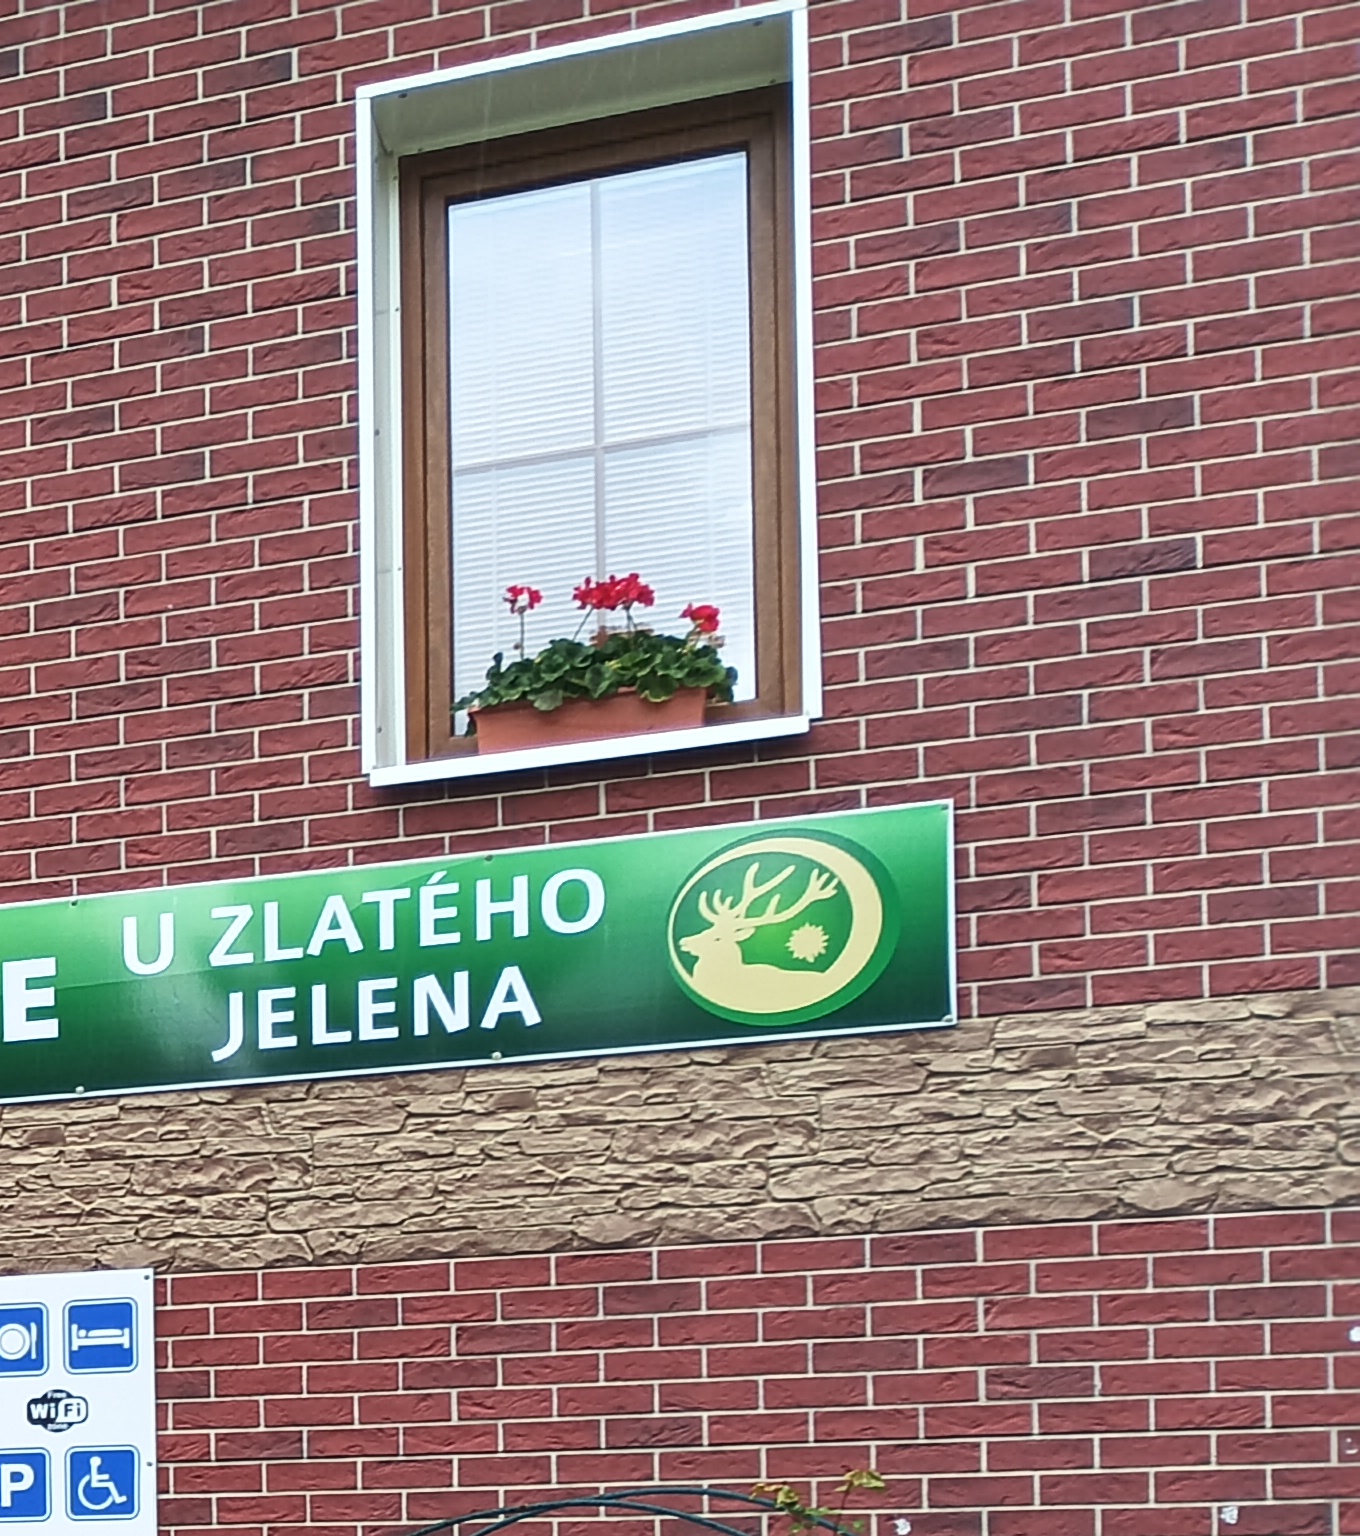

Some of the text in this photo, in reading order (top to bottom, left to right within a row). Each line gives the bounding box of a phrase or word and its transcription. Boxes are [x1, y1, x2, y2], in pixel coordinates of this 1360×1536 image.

[122, 867, 606, 976] U ZLATÉHO
[211, 965, 542, 1062] JELENA
[0, 1462, 35, 1508] P
